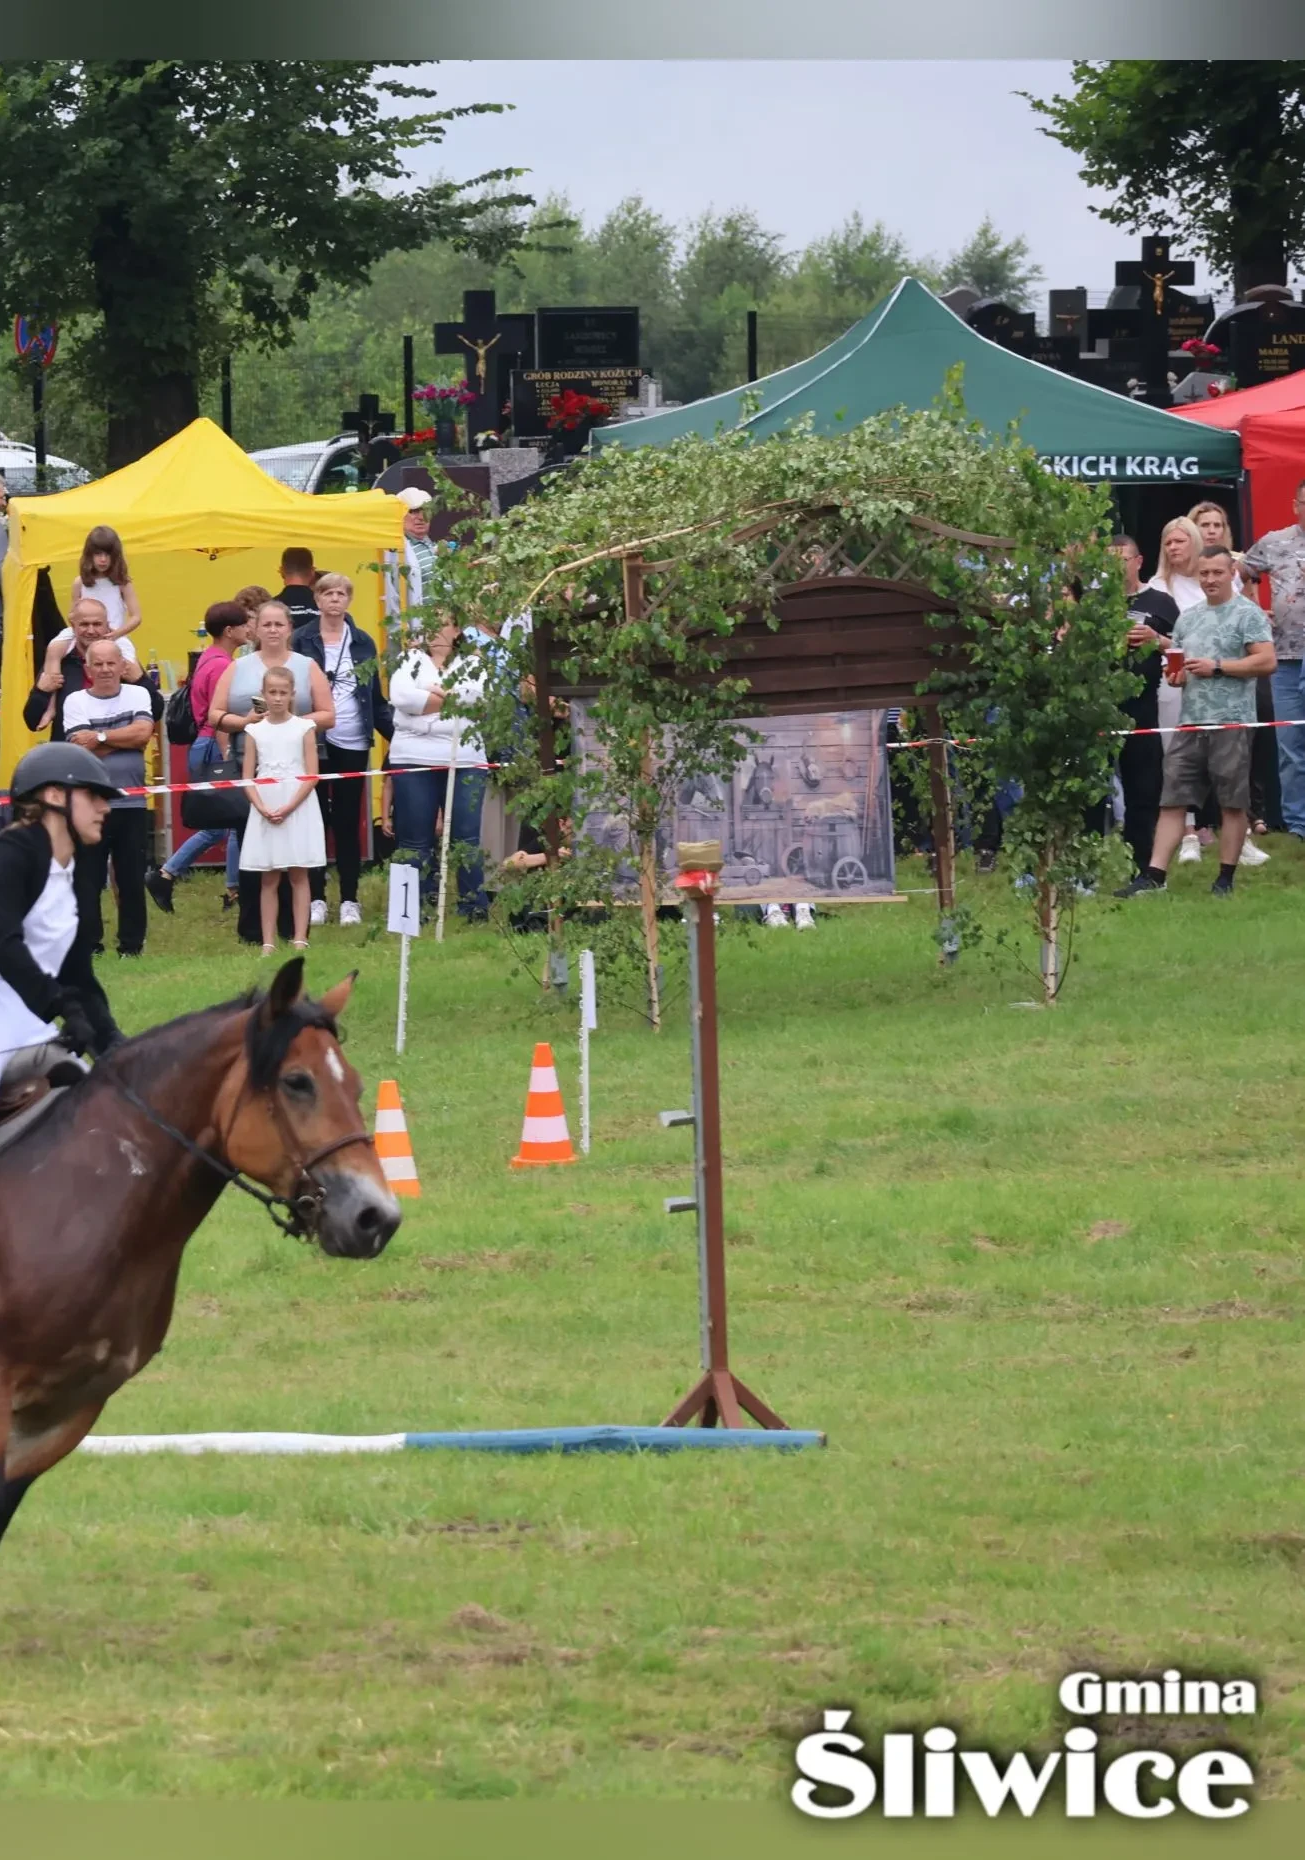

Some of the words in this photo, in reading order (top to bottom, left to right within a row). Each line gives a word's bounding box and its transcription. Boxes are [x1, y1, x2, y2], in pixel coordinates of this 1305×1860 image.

[523, 370, 552, 381] GRÓB
[554, 369, 598, 380] RODZINY
[1126, 455, 1199, 481] KRĄG
[401, 882, 411, 918] 1
